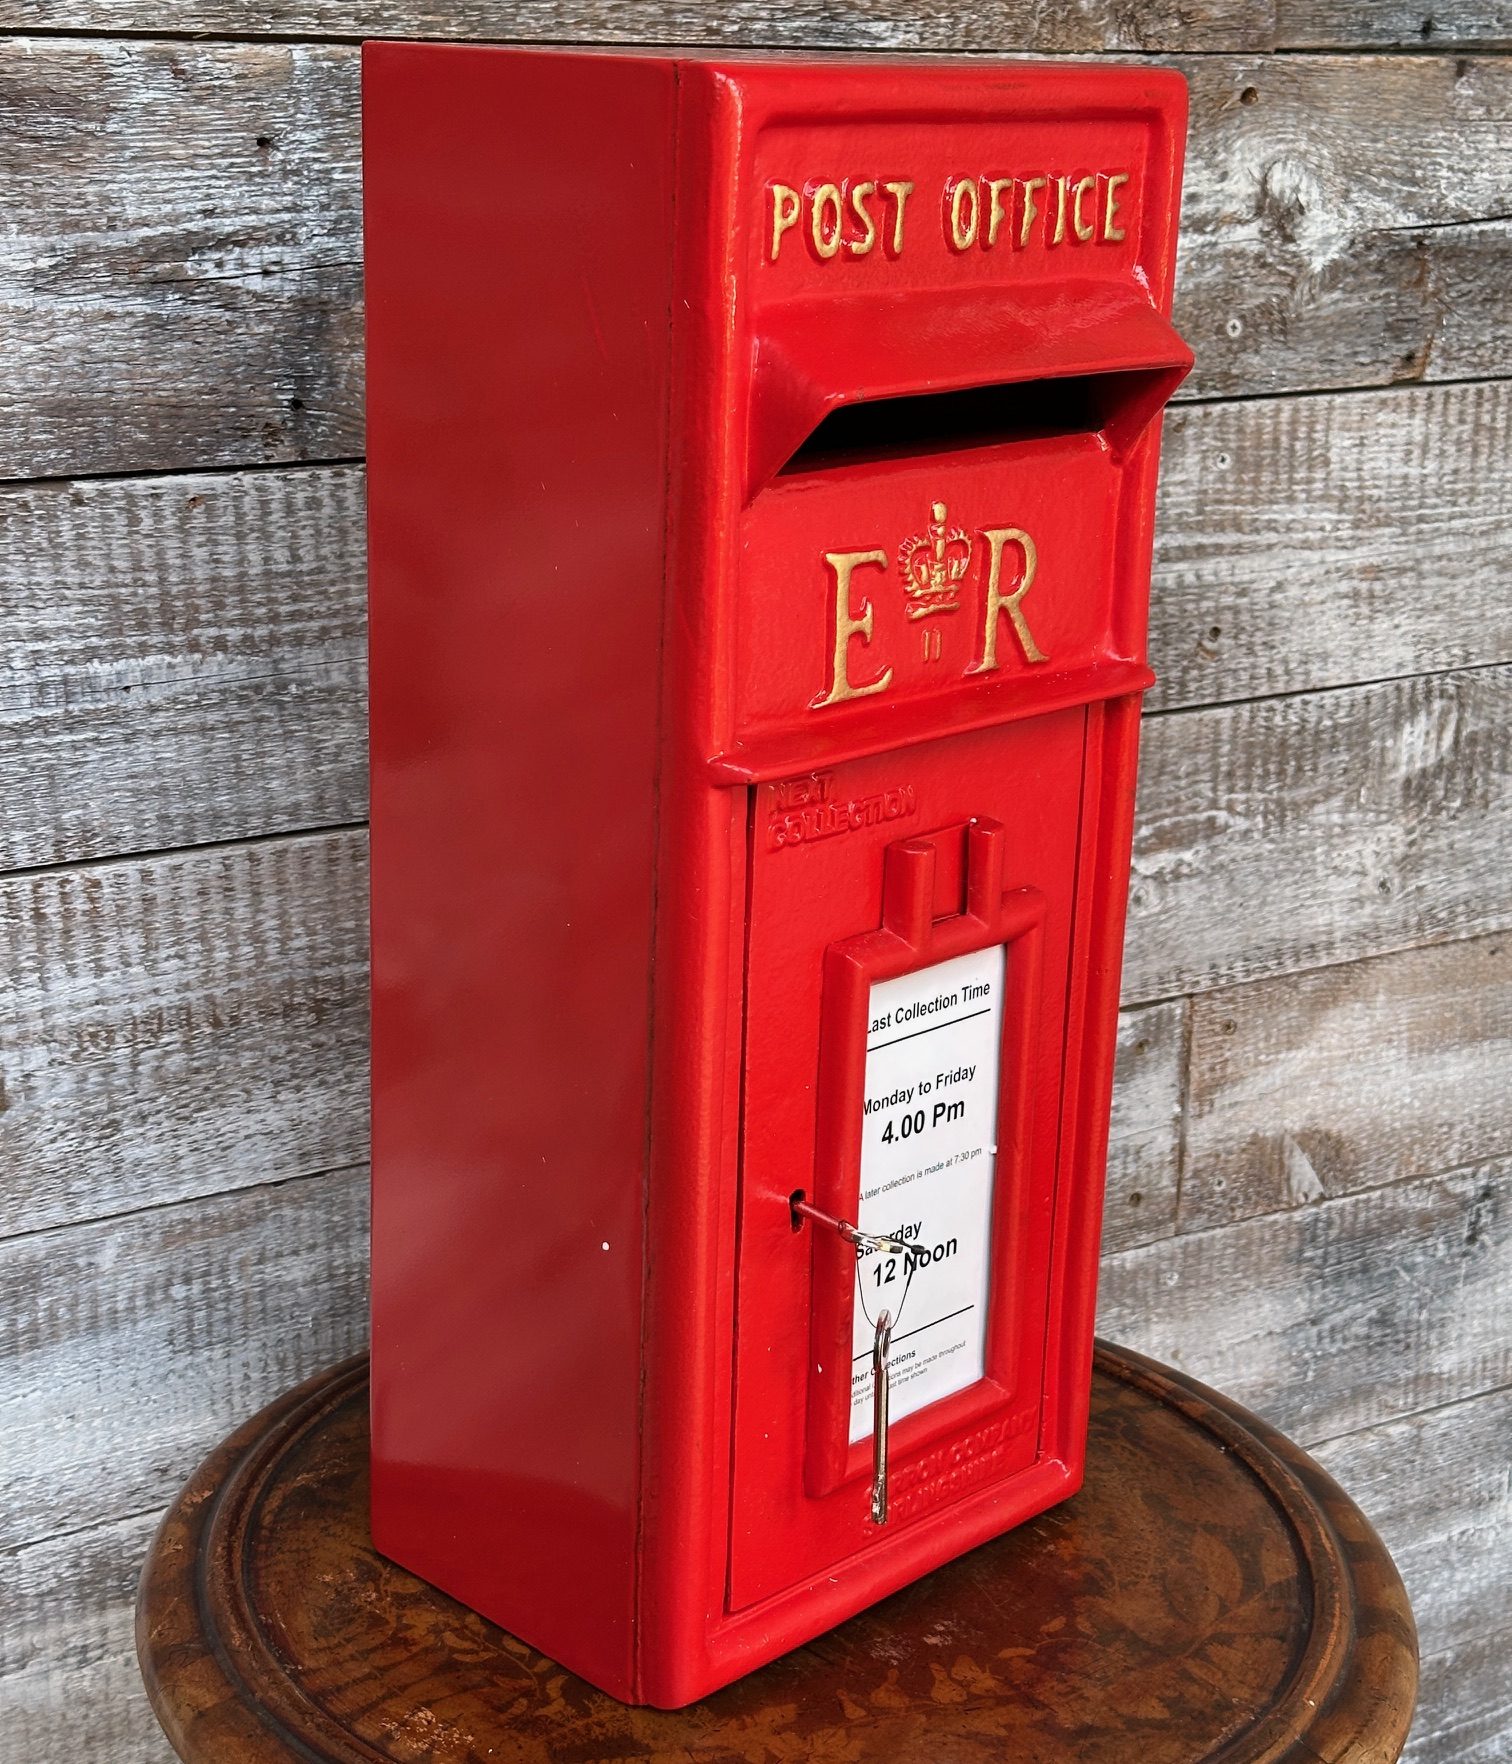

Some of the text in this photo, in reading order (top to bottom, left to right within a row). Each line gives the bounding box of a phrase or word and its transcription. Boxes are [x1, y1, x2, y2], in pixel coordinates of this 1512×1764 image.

[766, 172, 1130, 263] POST OFFICE
[808, 526, 1049, 709] E R
[767, 786, 917, 852] COLLECTION
[895, 993, 958, 1024] Collection
[961, 983, 990, 1003] Time
[863, 1065, 976, 1116] Monday to Friday
[881, 1100, 965, 1144] 4.00 Pm
[864, 1186, 880, 1200] later
[881, 1173, 915, 1192] collection
[916, 1170, 923, 1178] is
[924, 1162, 944, 1176] made
[945, 1158, 953, 1168] at
[970, 1148, 982, 1159] pm
[873, 1238, 957, 1287] 12 Noon
[852, 1372, 868, 1385] ther
